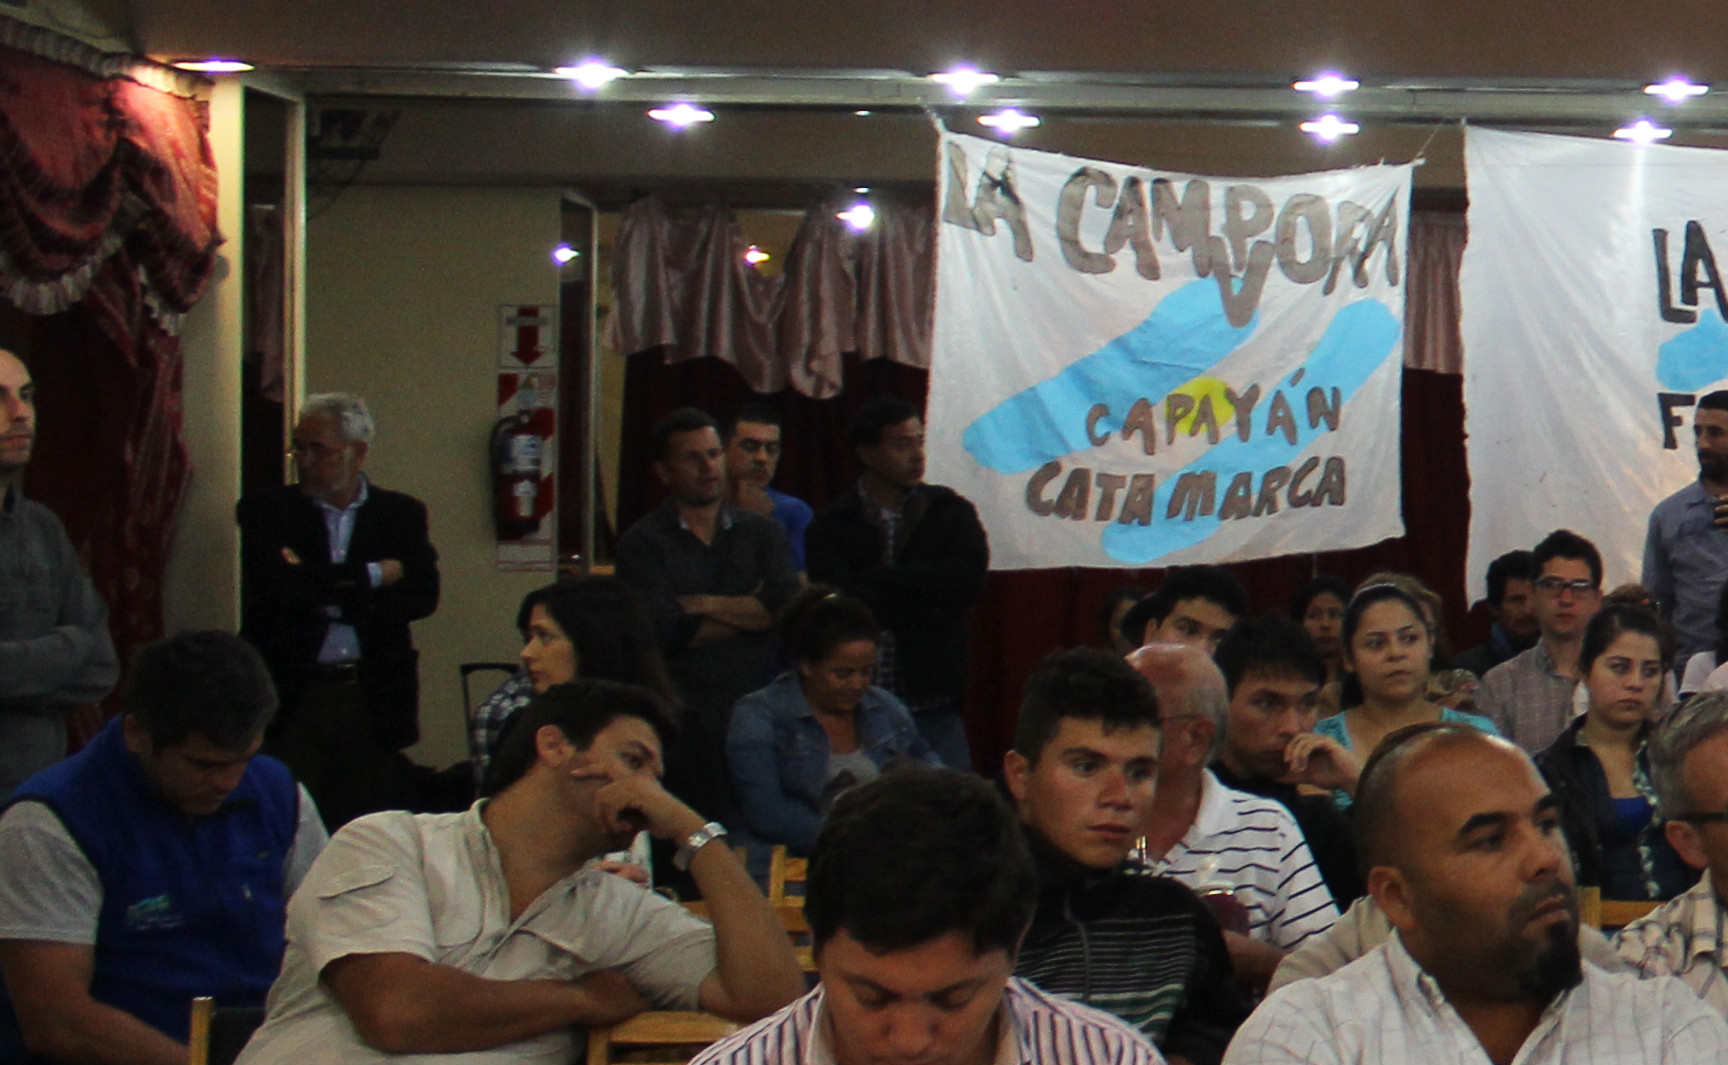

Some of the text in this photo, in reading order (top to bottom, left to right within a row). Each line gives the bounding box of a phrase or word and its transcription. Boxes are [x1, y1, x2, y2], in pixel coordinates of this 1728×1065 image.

[943, 140, 1399, 298] LA CAMPORA
[1086, 368, 1342, 455] CAPAYÁN
